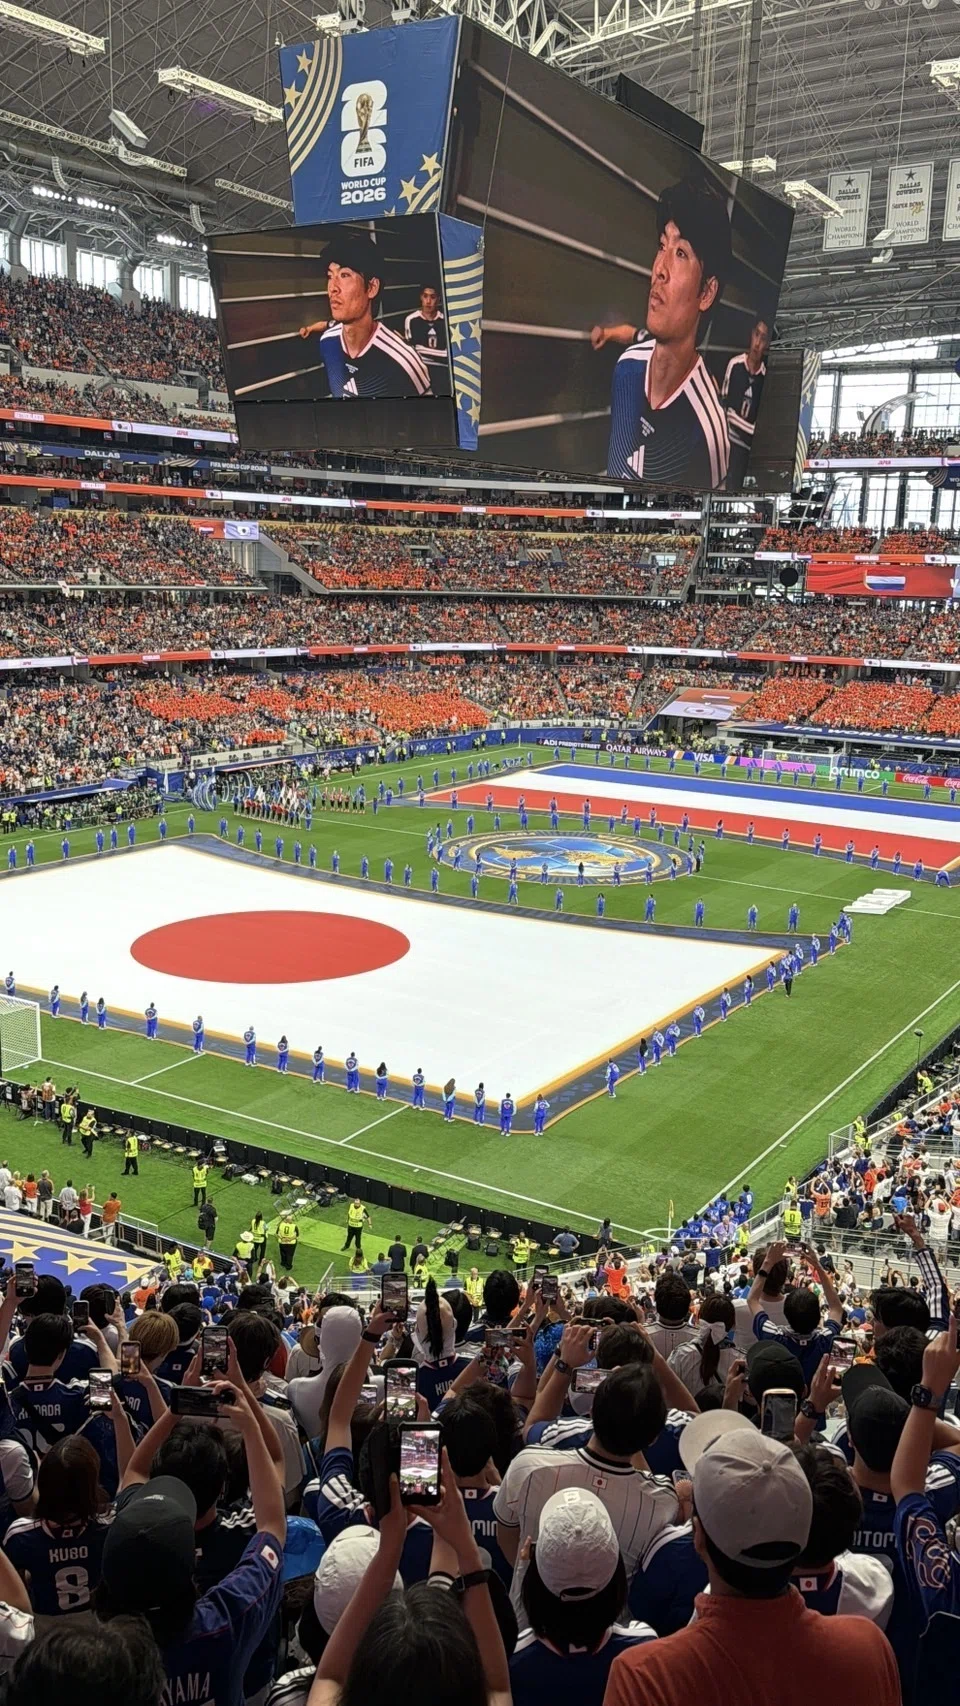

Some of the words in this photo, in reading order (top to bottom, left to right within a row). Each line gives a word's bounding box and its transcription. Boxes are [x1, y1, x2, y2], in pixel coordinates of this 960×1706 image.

[354, 156, 375, 168] FIFA
[341, 179, 370, 190] WORLD
[370, 177, 386, 187] CUP
[341, 187, 387, 205] 2026
[896, 188, 923, 196] COWBOYS
[84, 450, 121, 459] DALLAS
[828, 728, 899, 738] WORLD
[901, 734, 943, 742] CUP
[606, 744, 632, 754] QATAR
[634, 746, 667, 758] AIRWAYS
[692, 752, 715, 763] VISA
[832, 766, 880, 780] aramco
[49, 1546, 89, 1563] KUBO
[55, 1566, 90, 1610] 8
